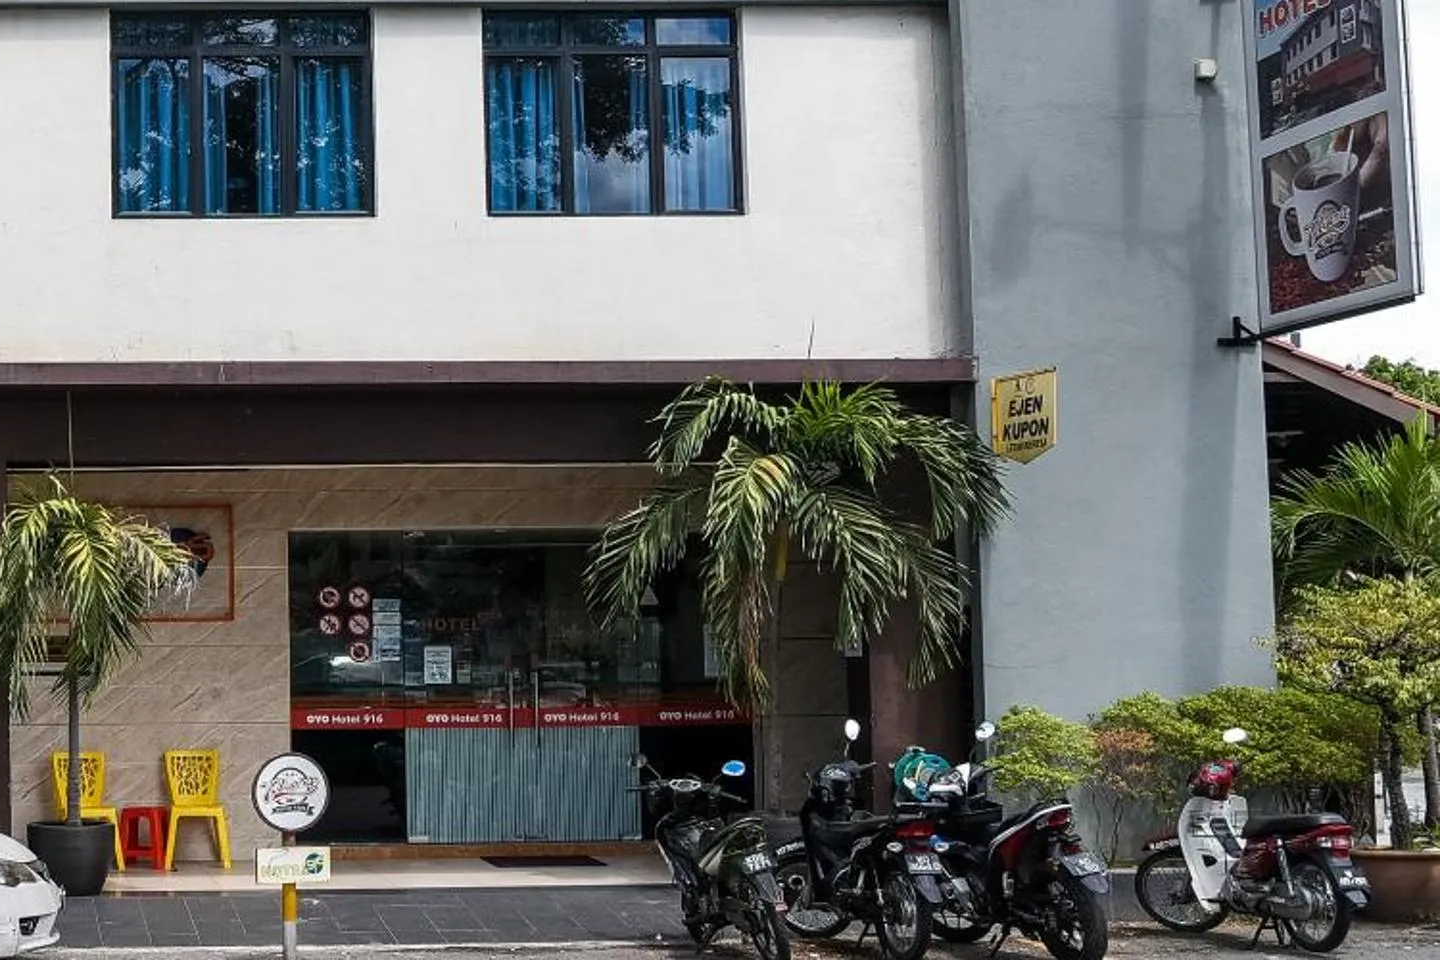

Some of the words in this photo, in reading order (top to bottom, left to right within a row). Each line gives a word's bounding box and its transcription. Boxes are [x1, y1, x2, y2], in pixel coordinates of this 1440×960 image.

[1008, 395, 1043, 418] EJEN
[1002, 417, 1049, 442] KUPON
[307, 714, 330, 724] OYO
[332, 714, 360, 724] Hotel
[364, 714, 383, 724] 916
